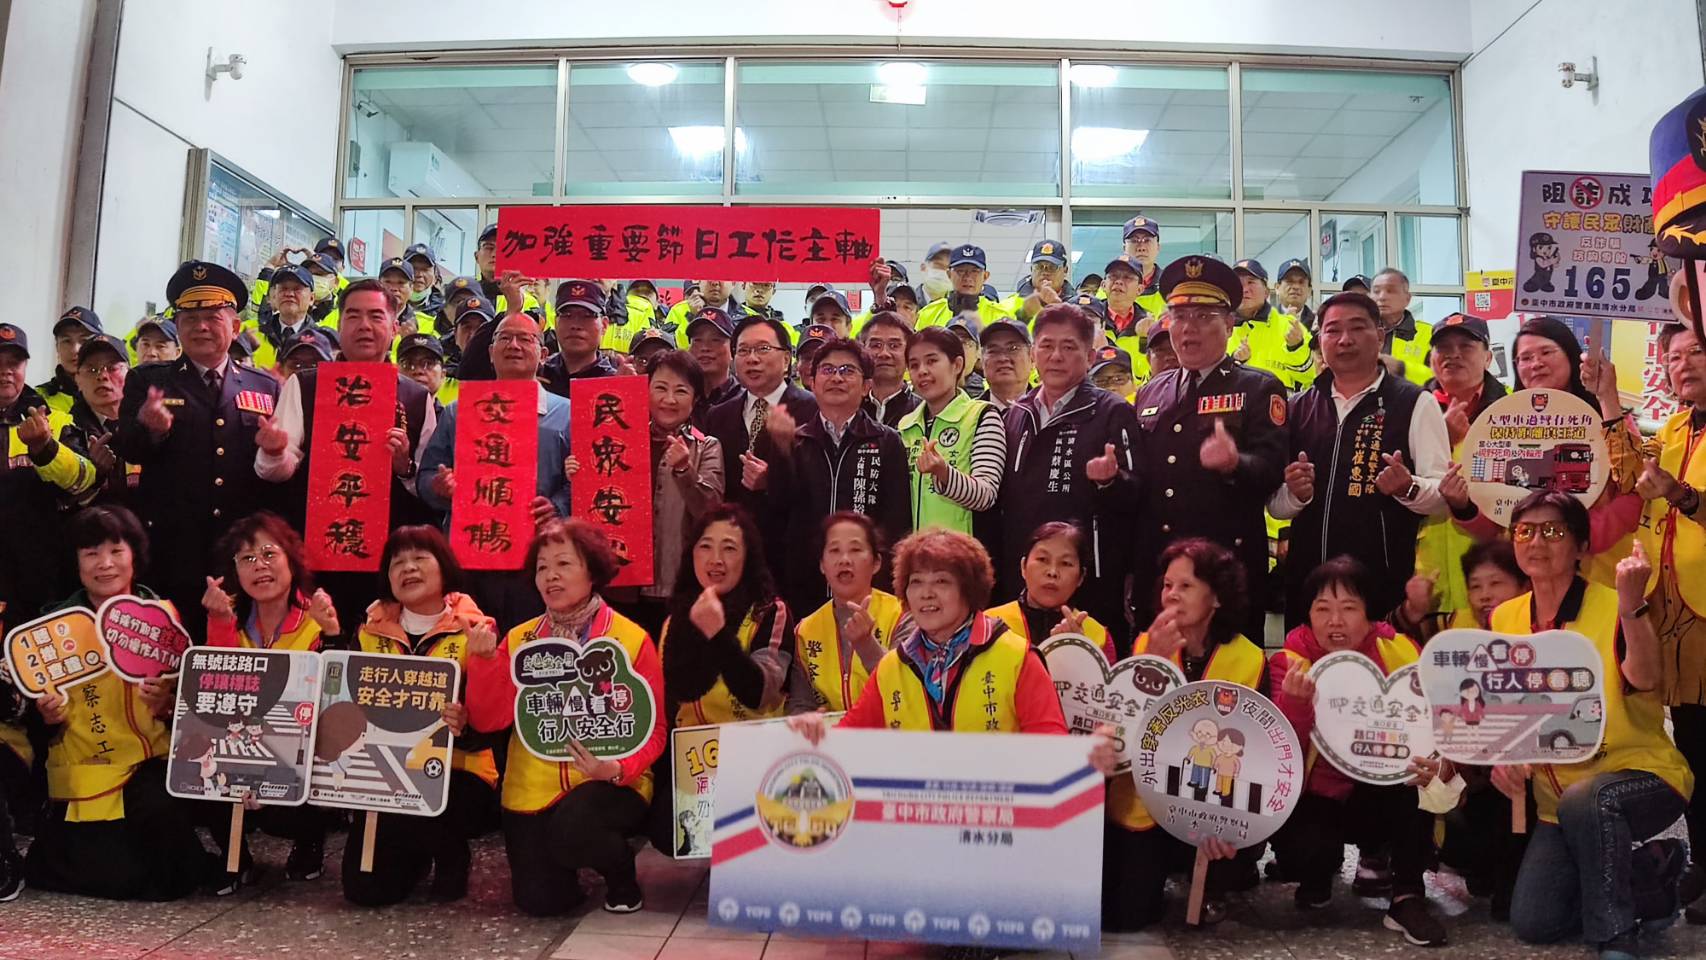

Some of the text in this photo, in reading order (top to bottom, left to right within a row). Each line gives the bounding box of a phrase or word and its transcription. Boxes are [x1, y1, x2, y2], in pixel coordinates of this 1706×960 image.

[1564, 265, 1631, 301] 165
[867, 455, 881, 505] 民防大隊
[20, 635, 30, 649] 1
[27, 654, 39, 668] 2
[192, 653, 269, 672] 無號誌路口
[34, 671, 47, 685] 3
[359, 666, 449, 689] 走行人穿越道
[196, 692, 258, 716] 要遵守
[357, 686, 447, 712] 安全才可靠
[1351, 695, 1429, 723] 交通安全
[82, 683, 114, 755] 察志工
[537, 713, 634, 744] 行人安全行
[882, 802, 1014, 827] 臺中市政府警察局
[960, 829, 1013, 846] 清水分局
